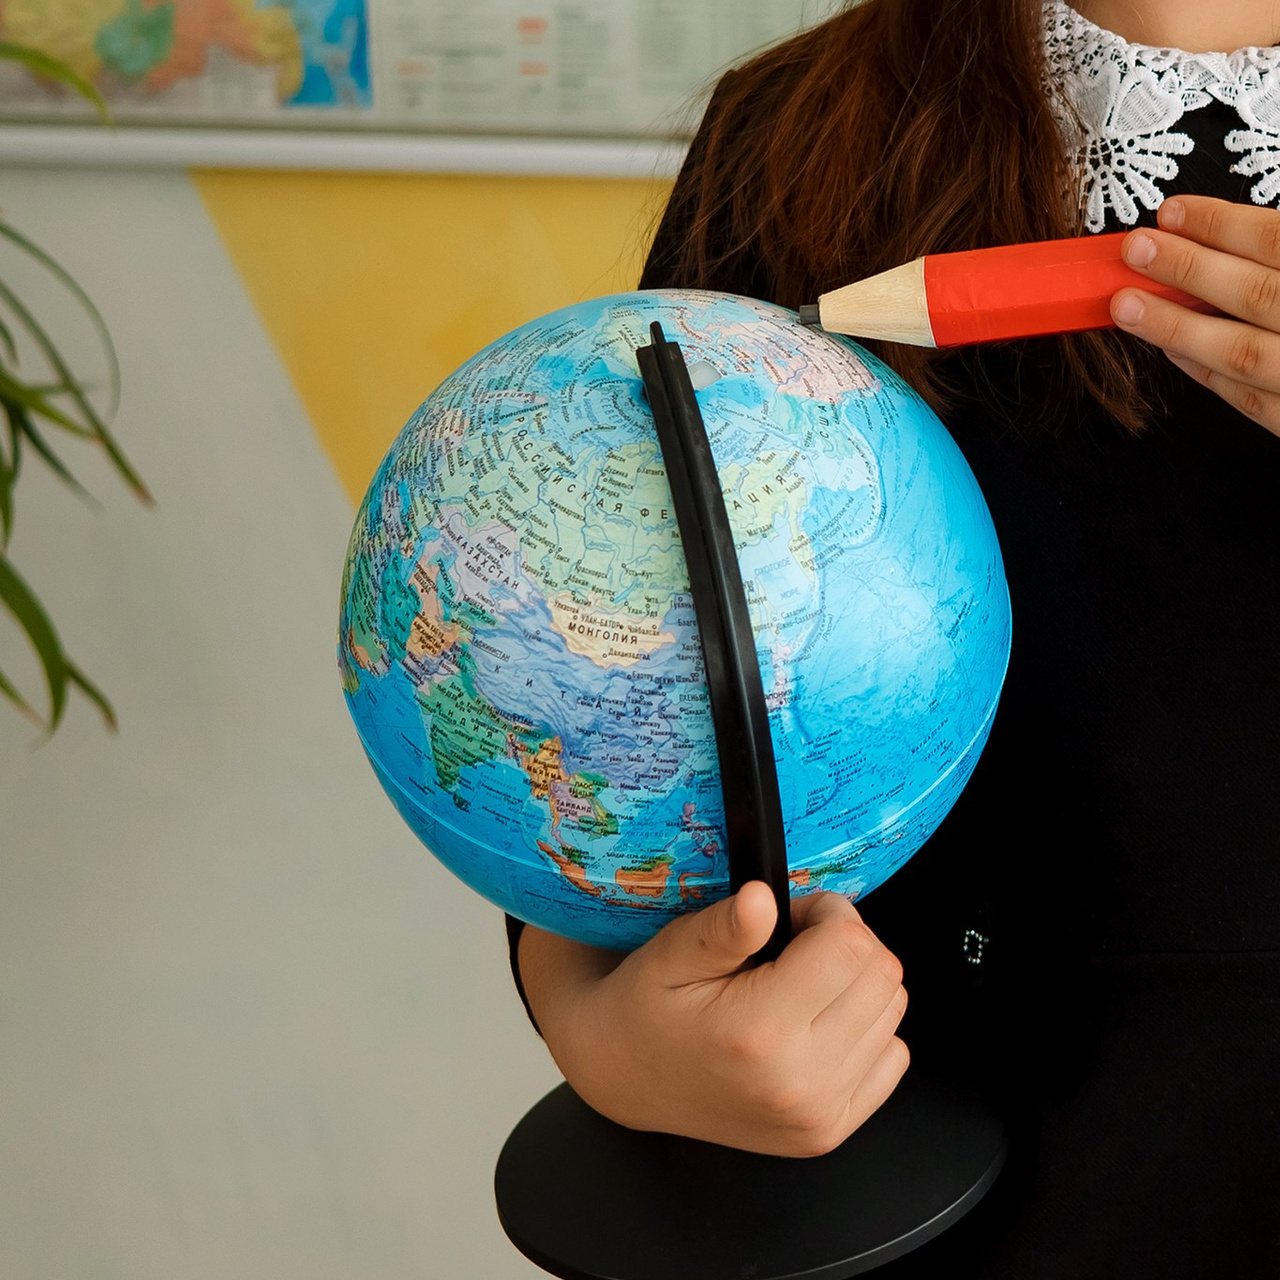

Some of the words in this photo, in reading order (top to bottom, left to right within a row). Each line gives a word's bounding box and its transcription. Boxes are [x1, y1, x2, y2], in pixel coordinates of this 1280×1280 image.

[515, 416, 623, 514] РОССИЙСКАЯ
[456, 536, 520, 590] КАЗАХСТАН
[568, 622, 638, 645] МОНГОЛИЯ
